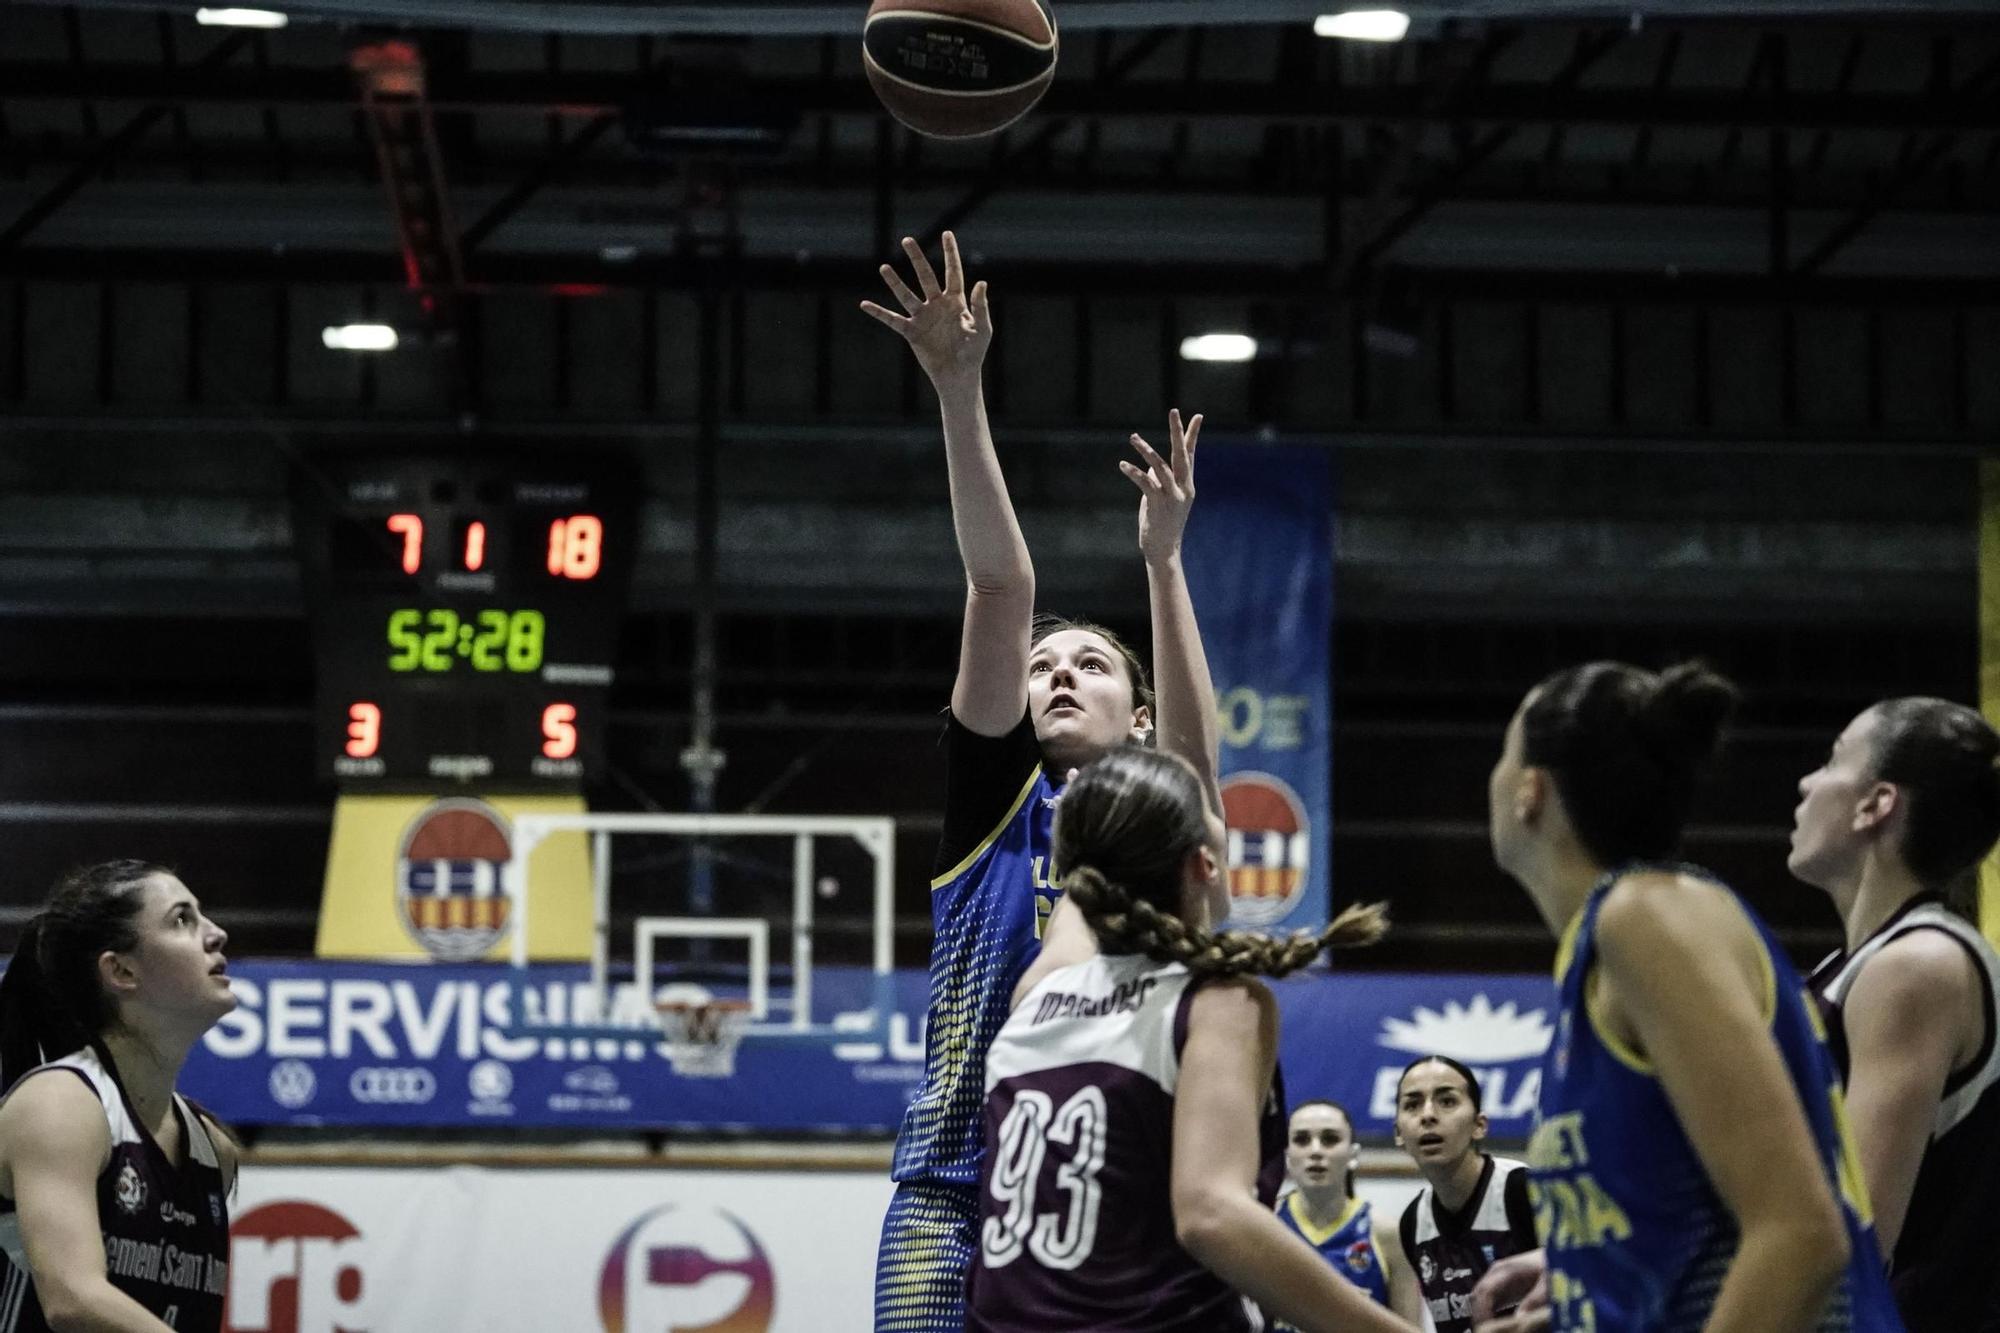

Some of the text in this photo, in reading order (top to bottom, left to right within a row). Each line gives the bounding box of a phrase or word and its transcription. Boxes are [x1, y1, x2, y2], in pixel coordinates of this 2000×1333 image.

[386, 513, 424, 575] 7
[464, 521, 486, 572] 1
[546, 514, 603, 580] 18
[387, 608, 546, 673] 52:28
[345, 701, 381, 759] 3
[541, 702, 578, 759] 5
[982, 1084, 1106, 1271] 93
